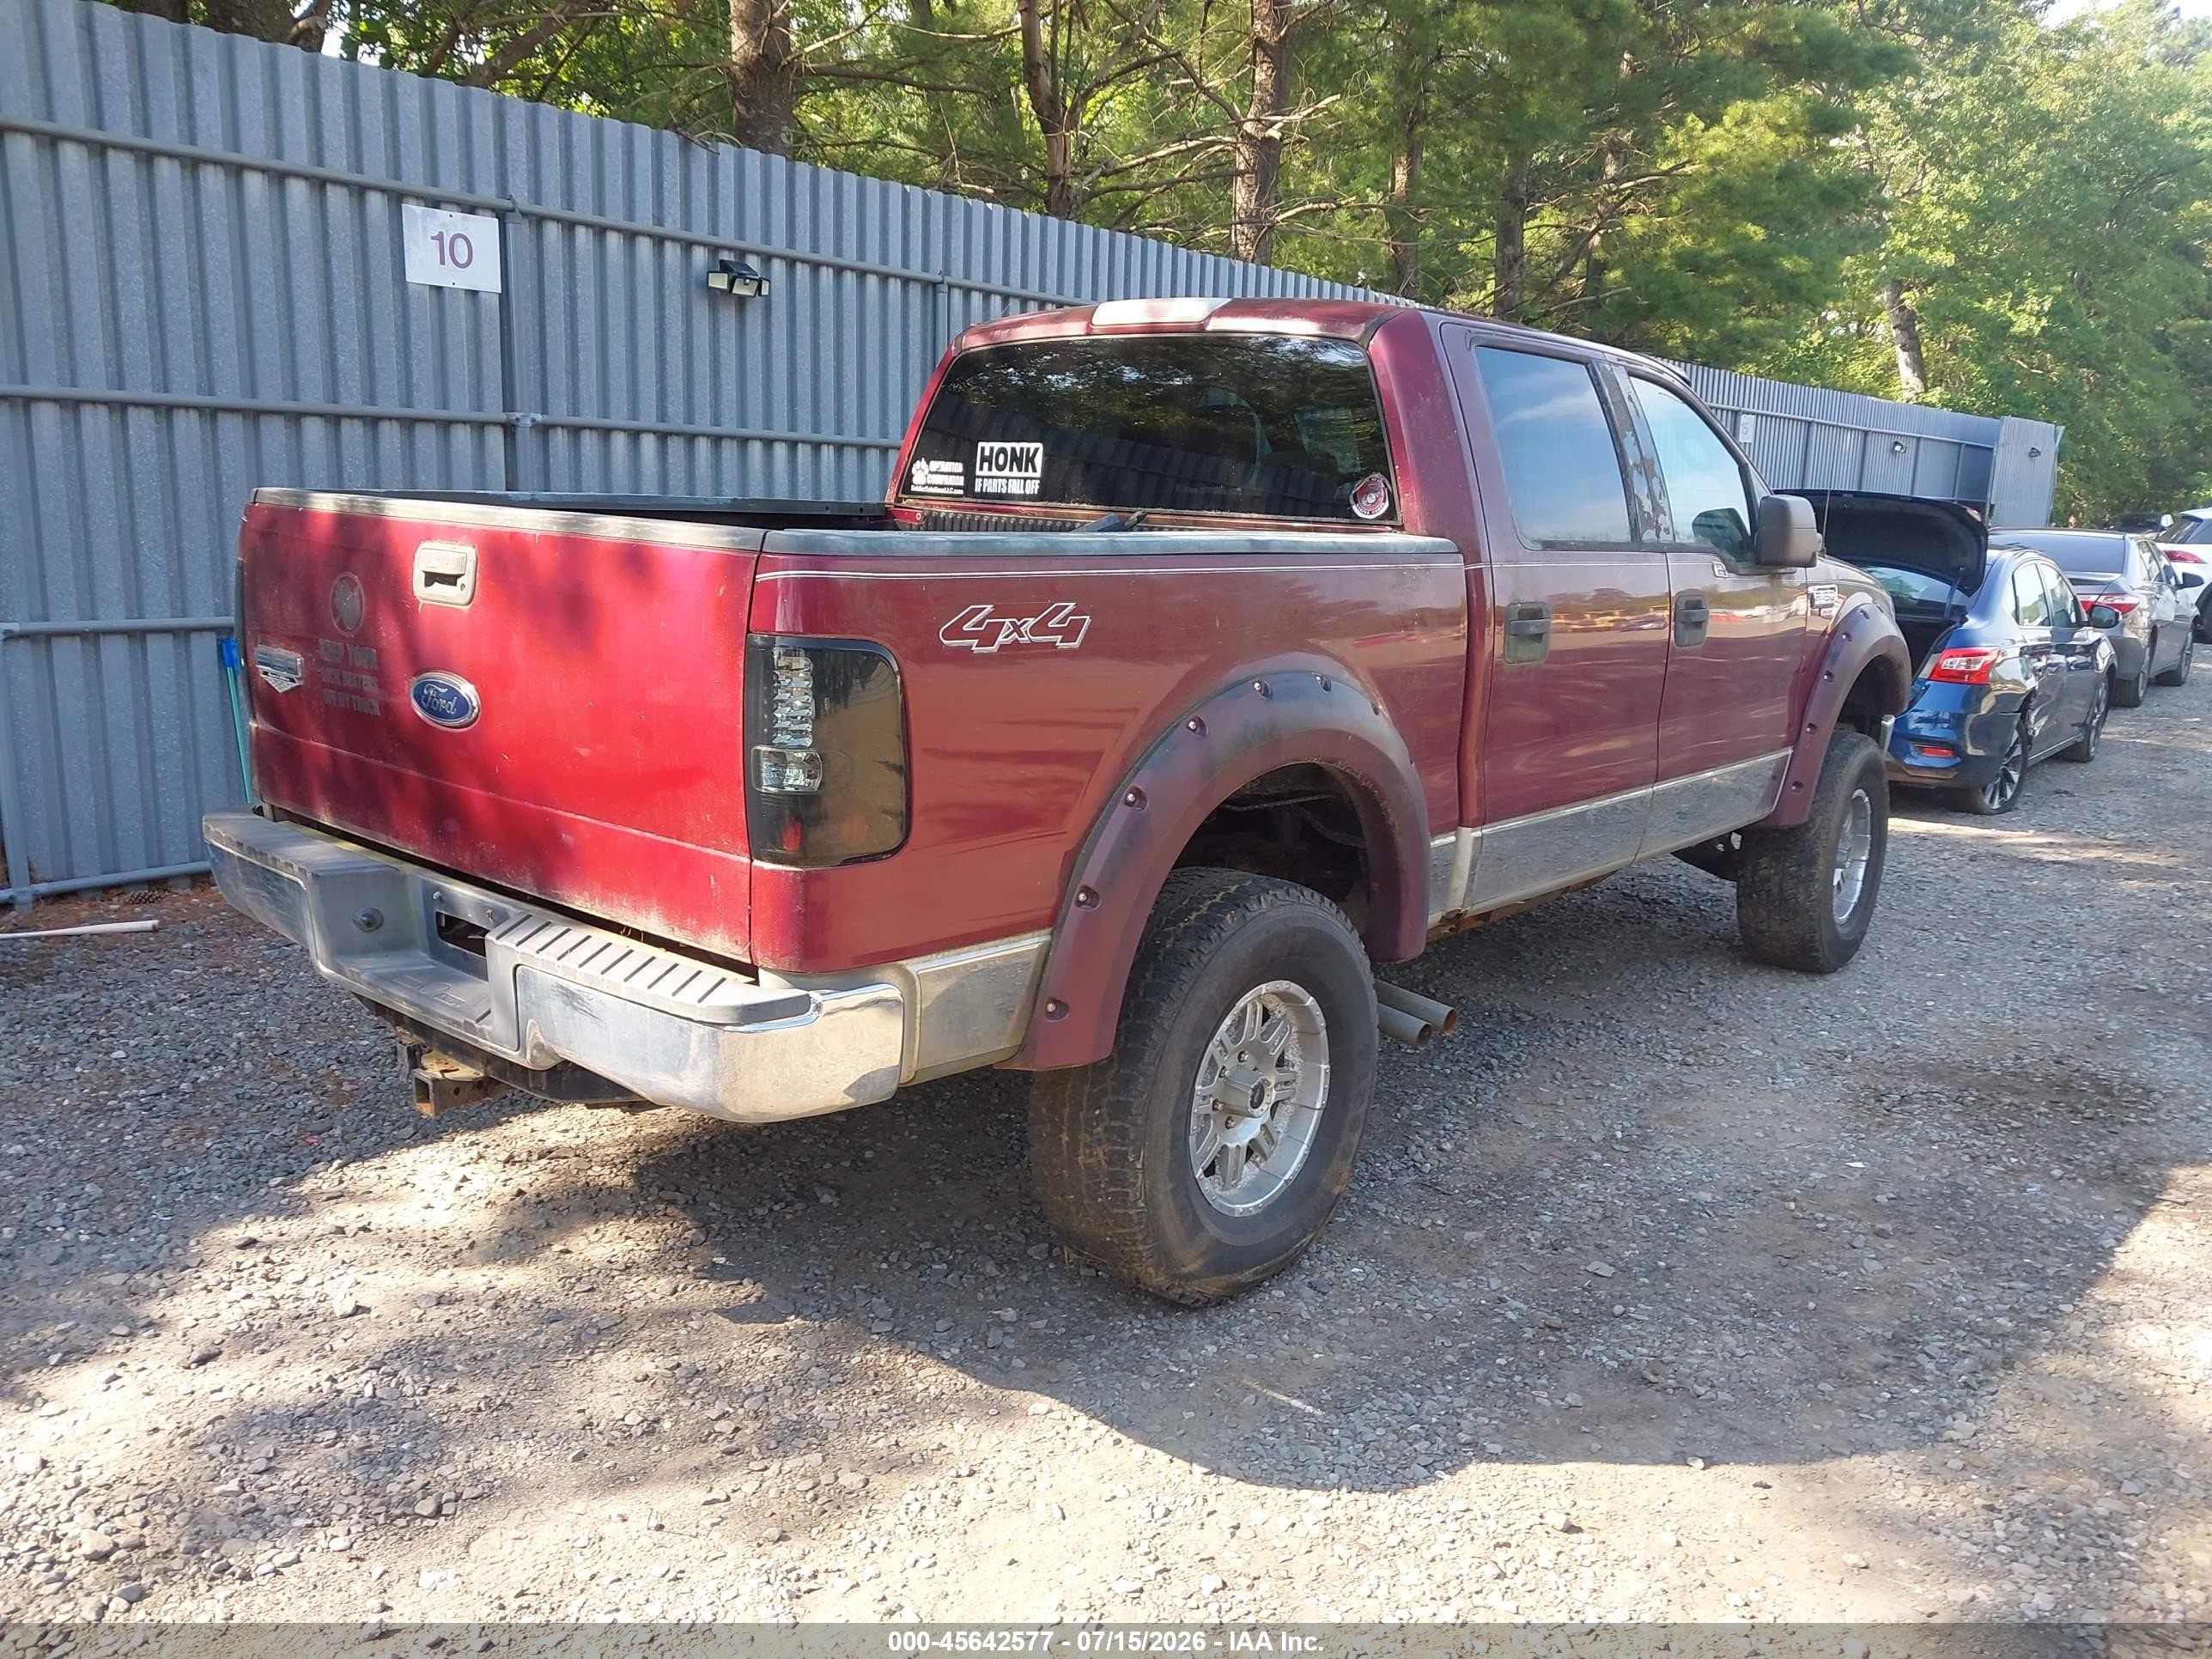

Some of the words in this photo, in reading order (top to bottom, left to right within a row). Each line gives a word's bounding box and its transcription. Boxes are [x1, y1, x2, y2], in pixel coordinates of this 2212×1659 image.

[430, 231, 473, 269] 10
[979, 446, 1040, 473] HONK
[975, 477, 982, 492] IF
[982, 478, 1007, 493] PARTS
[1007, 479, 1024, 494] FALL
[1025, 479, 1041, 495] OFF
[939, 603, 1091, 653] 4x4
[421, 683, 459, 714] Ford
